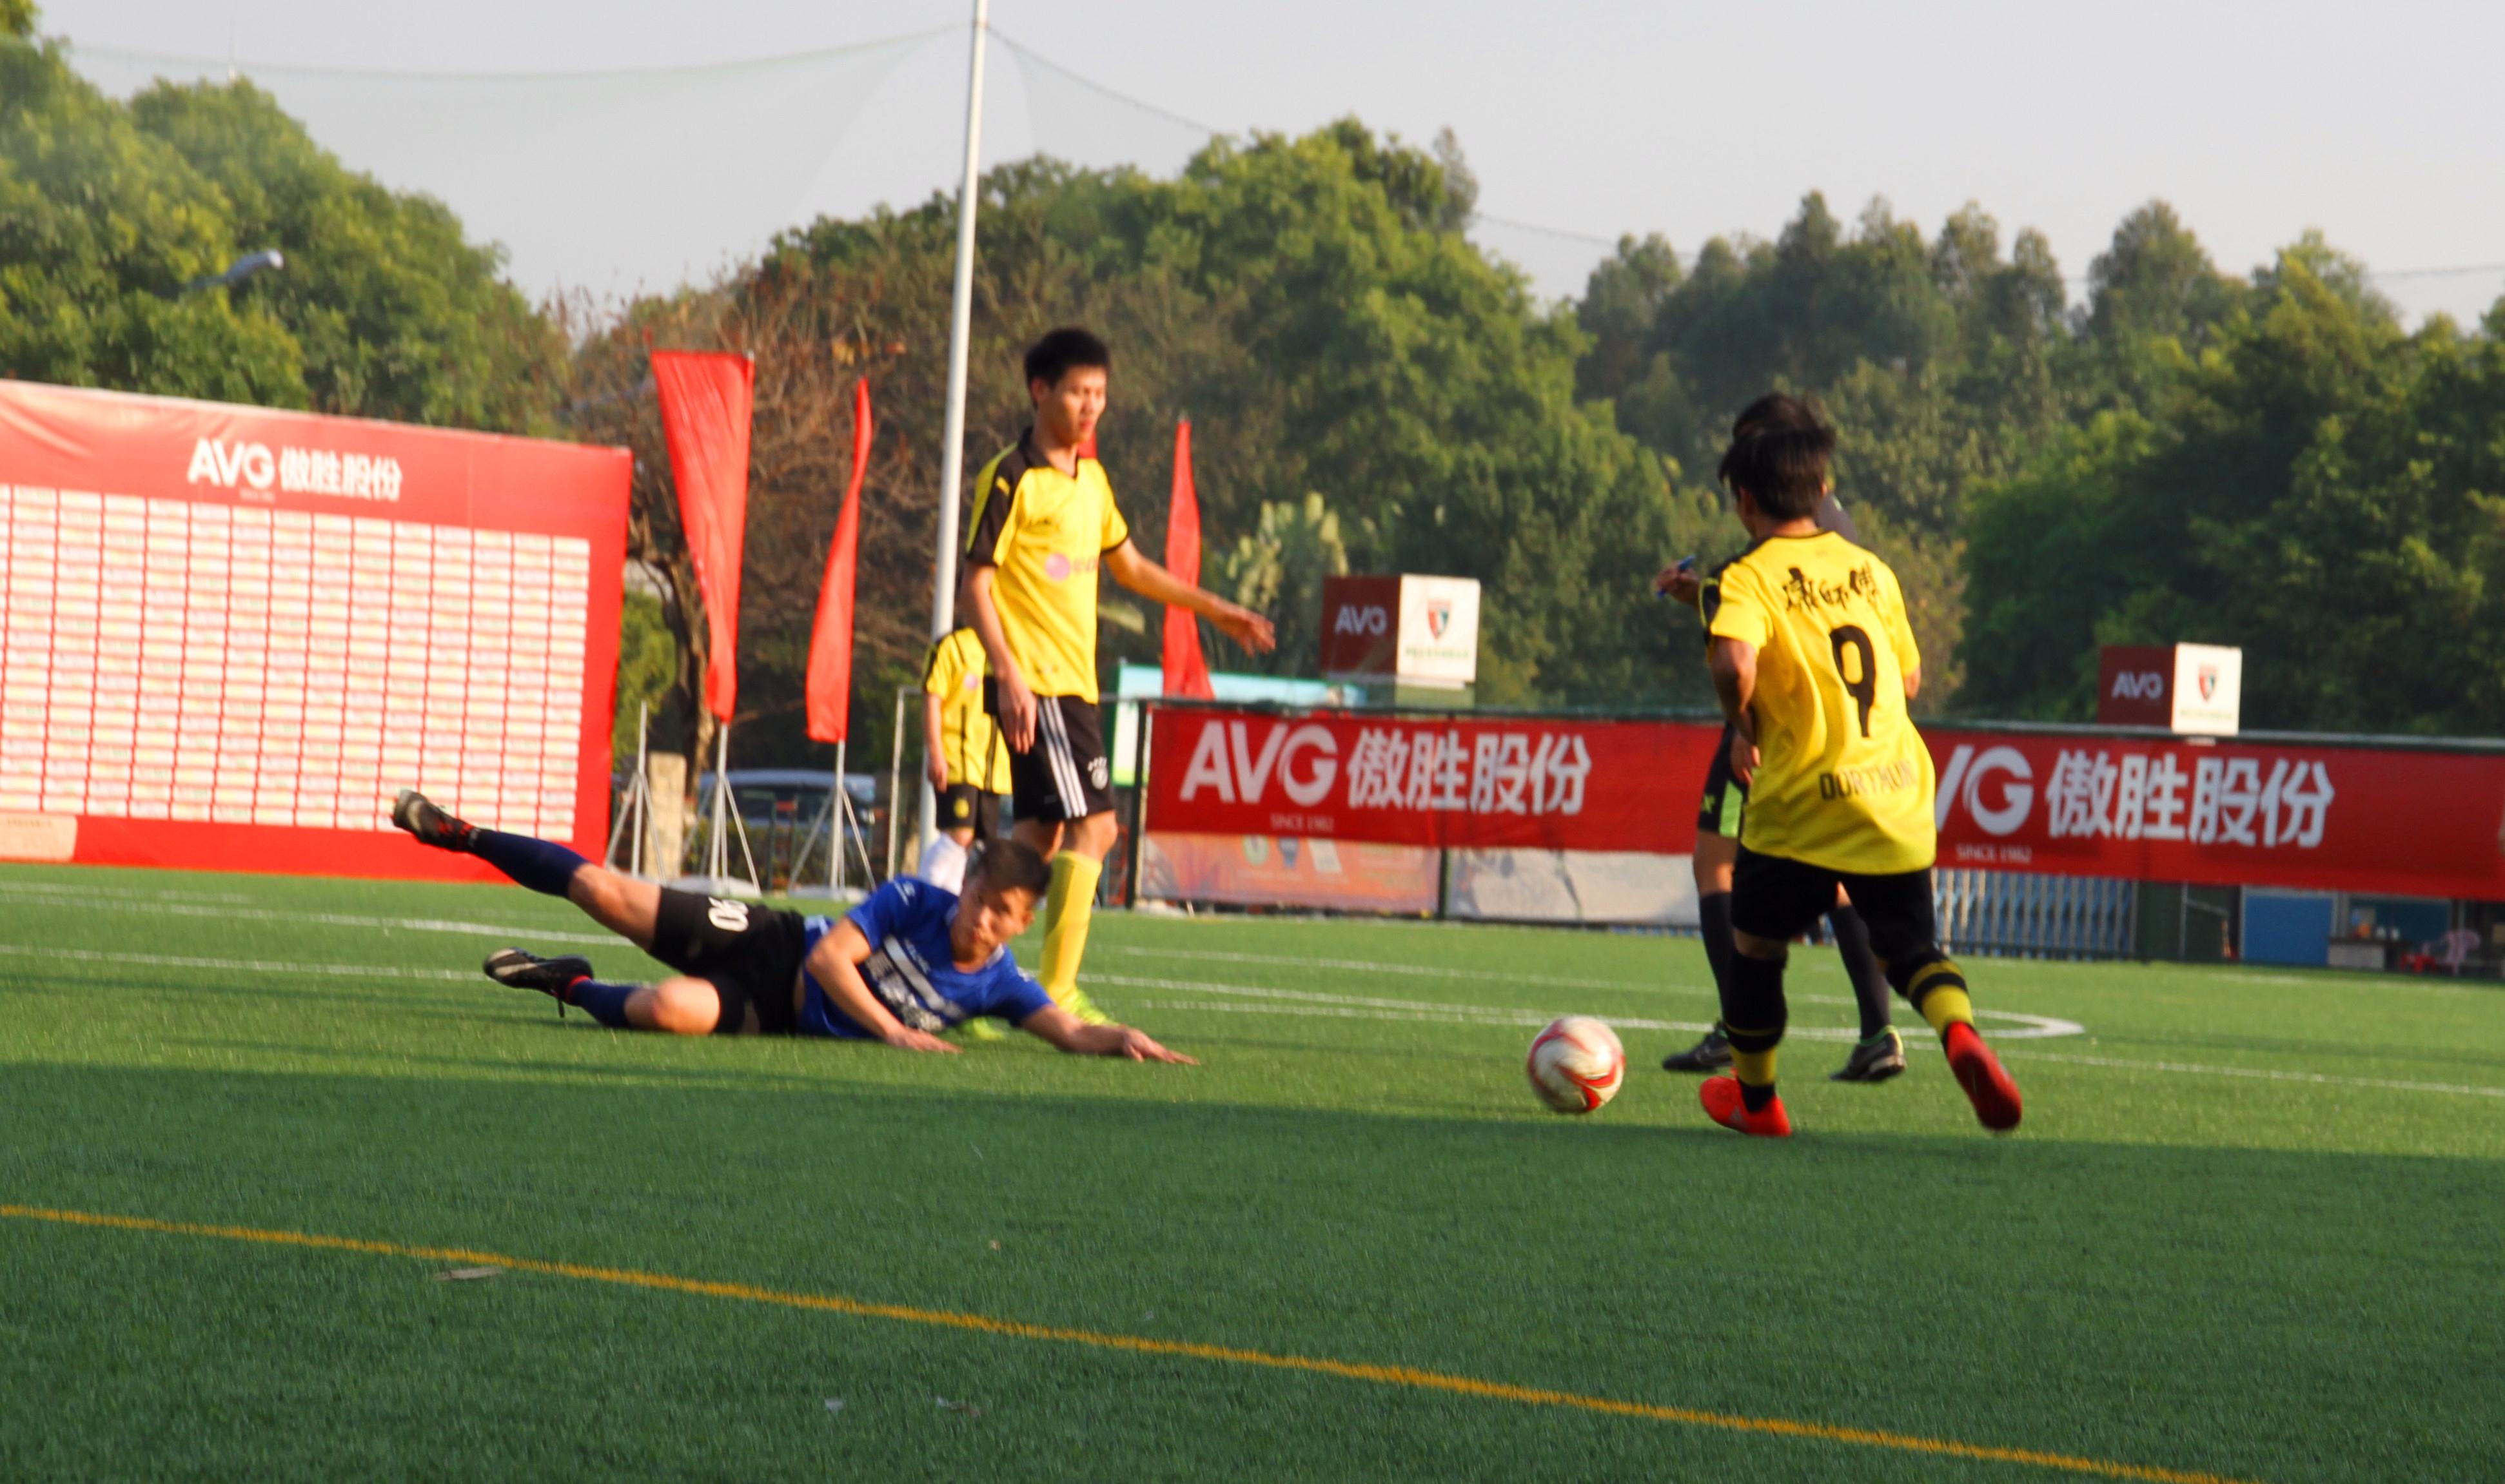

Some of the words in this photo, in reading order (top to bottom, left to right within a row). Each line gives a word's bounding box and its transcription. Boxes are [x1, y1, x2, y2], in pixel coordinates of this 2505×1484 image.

[186, 436, 276, 489] AVG
[1829, 625, 1876, 737] 9
[1179, 720, 1338, 806] AVG
[1347, 727, 1592, 815] 傲胜股份
[2045, 748, 2335, 849] 傲胜股份
[1956, 843, 1996, 862] SINCE
